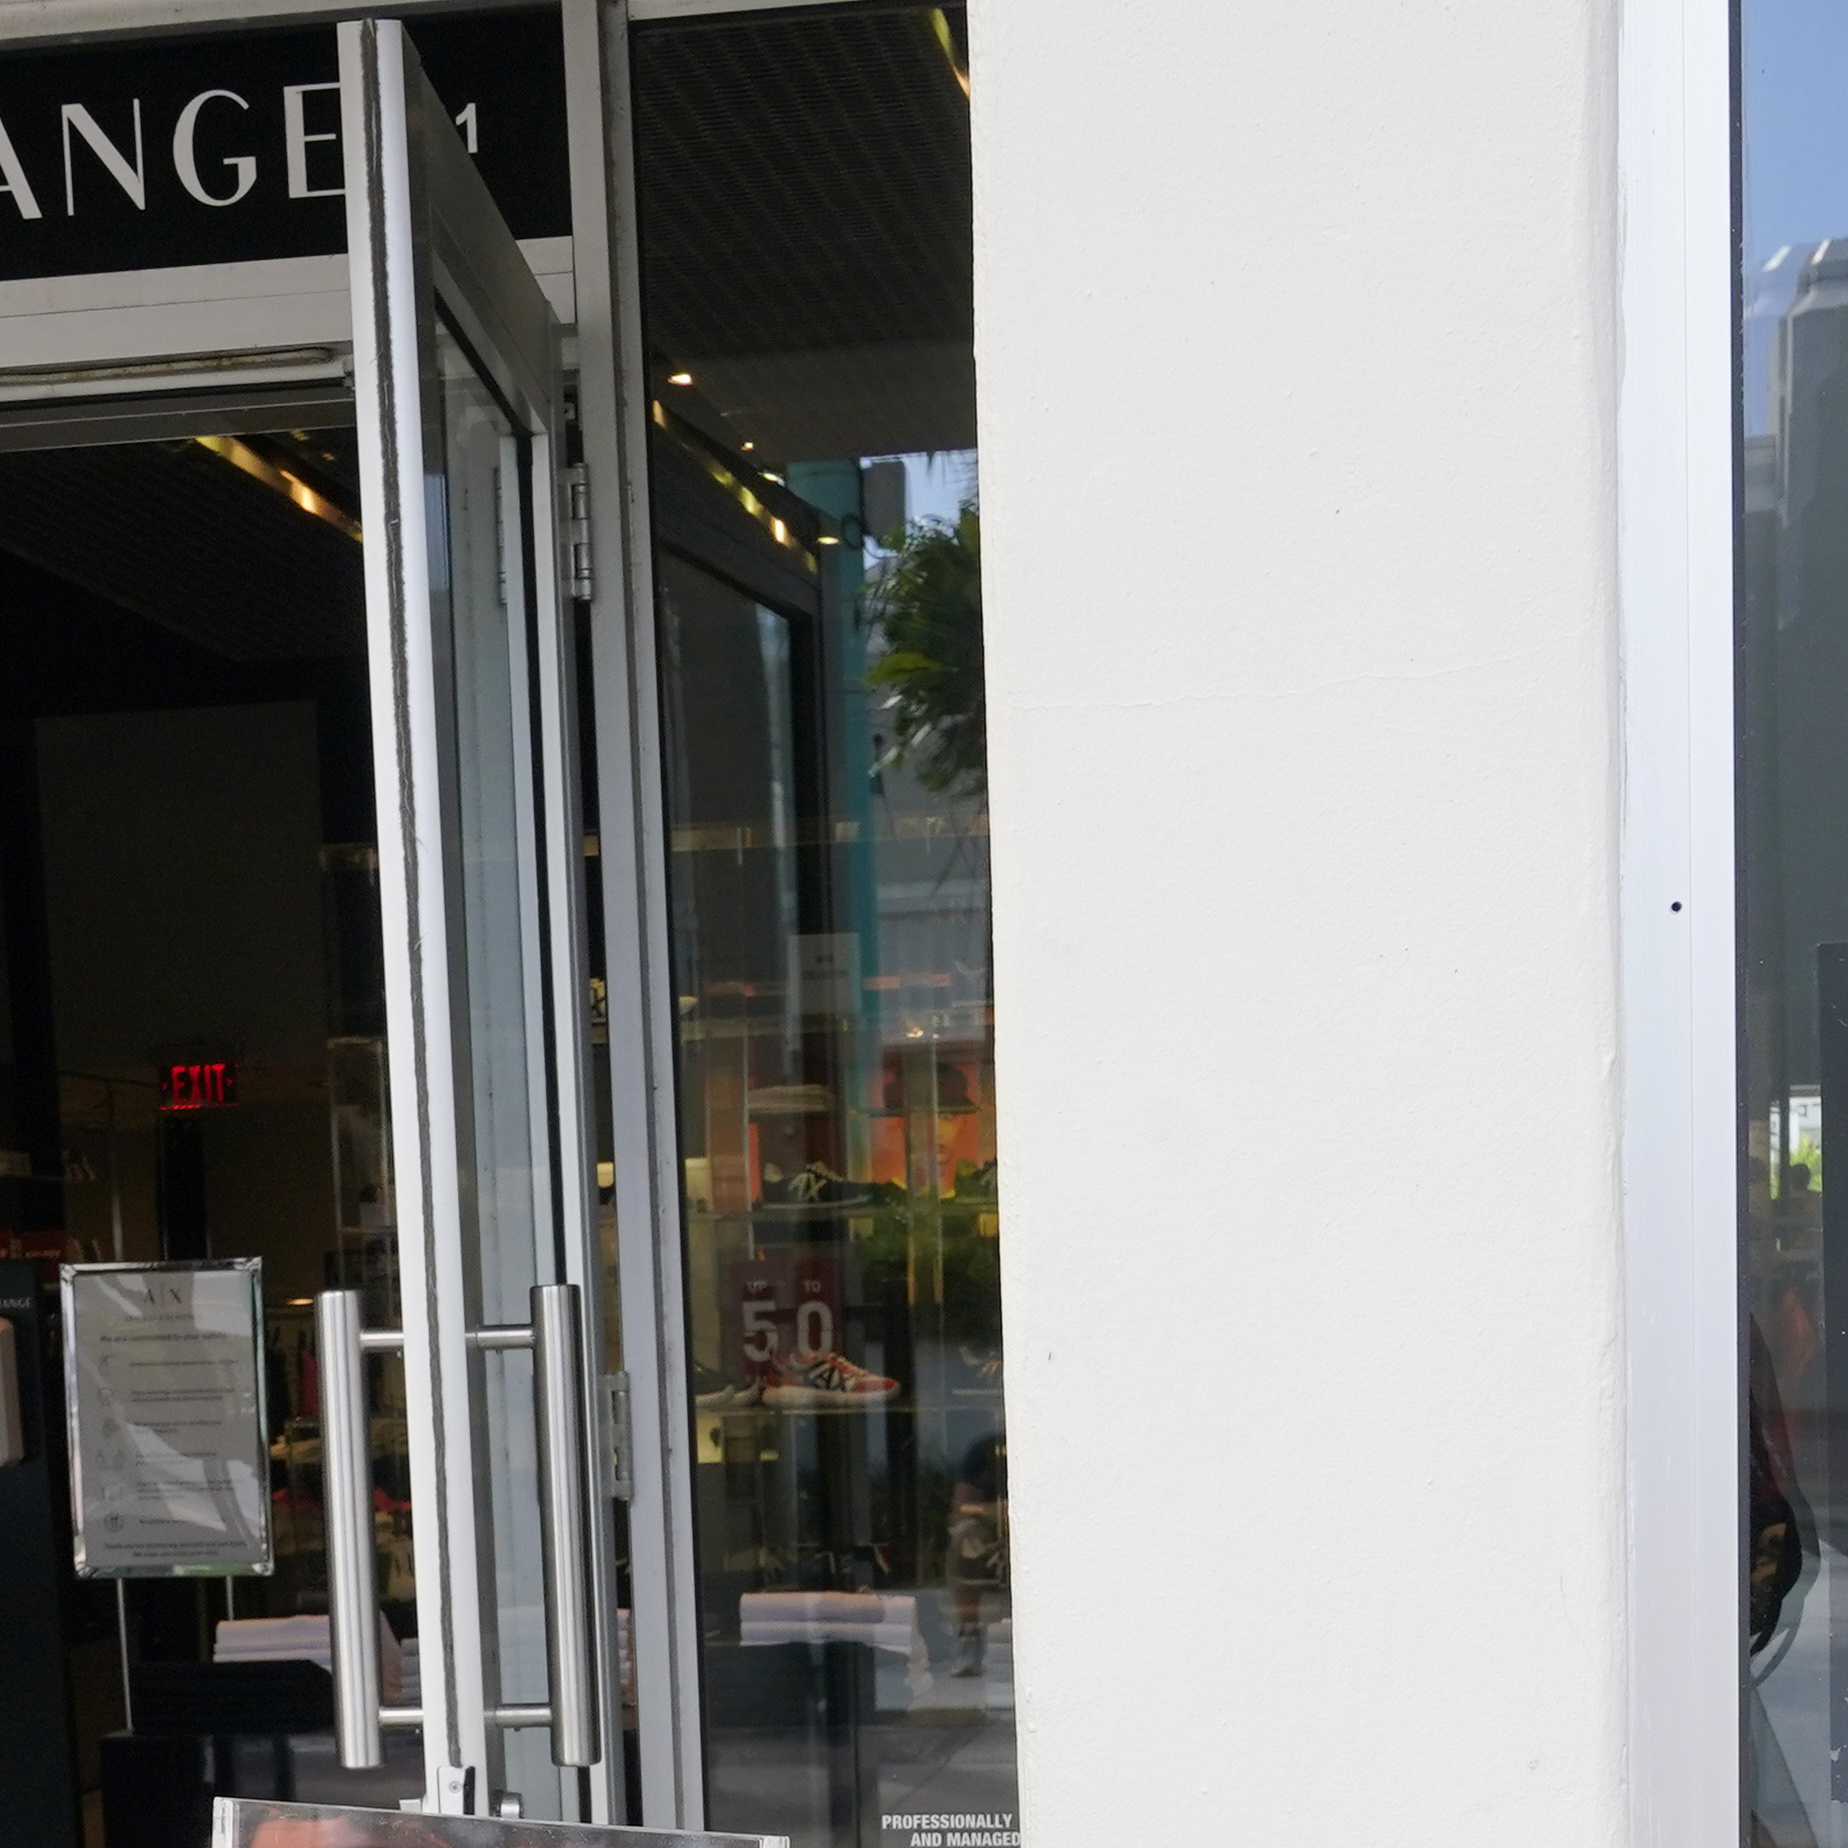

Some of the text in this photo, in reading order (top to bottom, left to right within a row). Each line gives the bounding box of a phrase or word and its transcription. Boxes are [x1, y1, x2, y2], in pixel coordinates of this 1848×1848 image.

[169, 1063, 227, 1105] EXIT
[881, 1813, 1013, 1831] PROFESSIONALLY
[910, 1831, 1022, 1848] AND MANAGED
